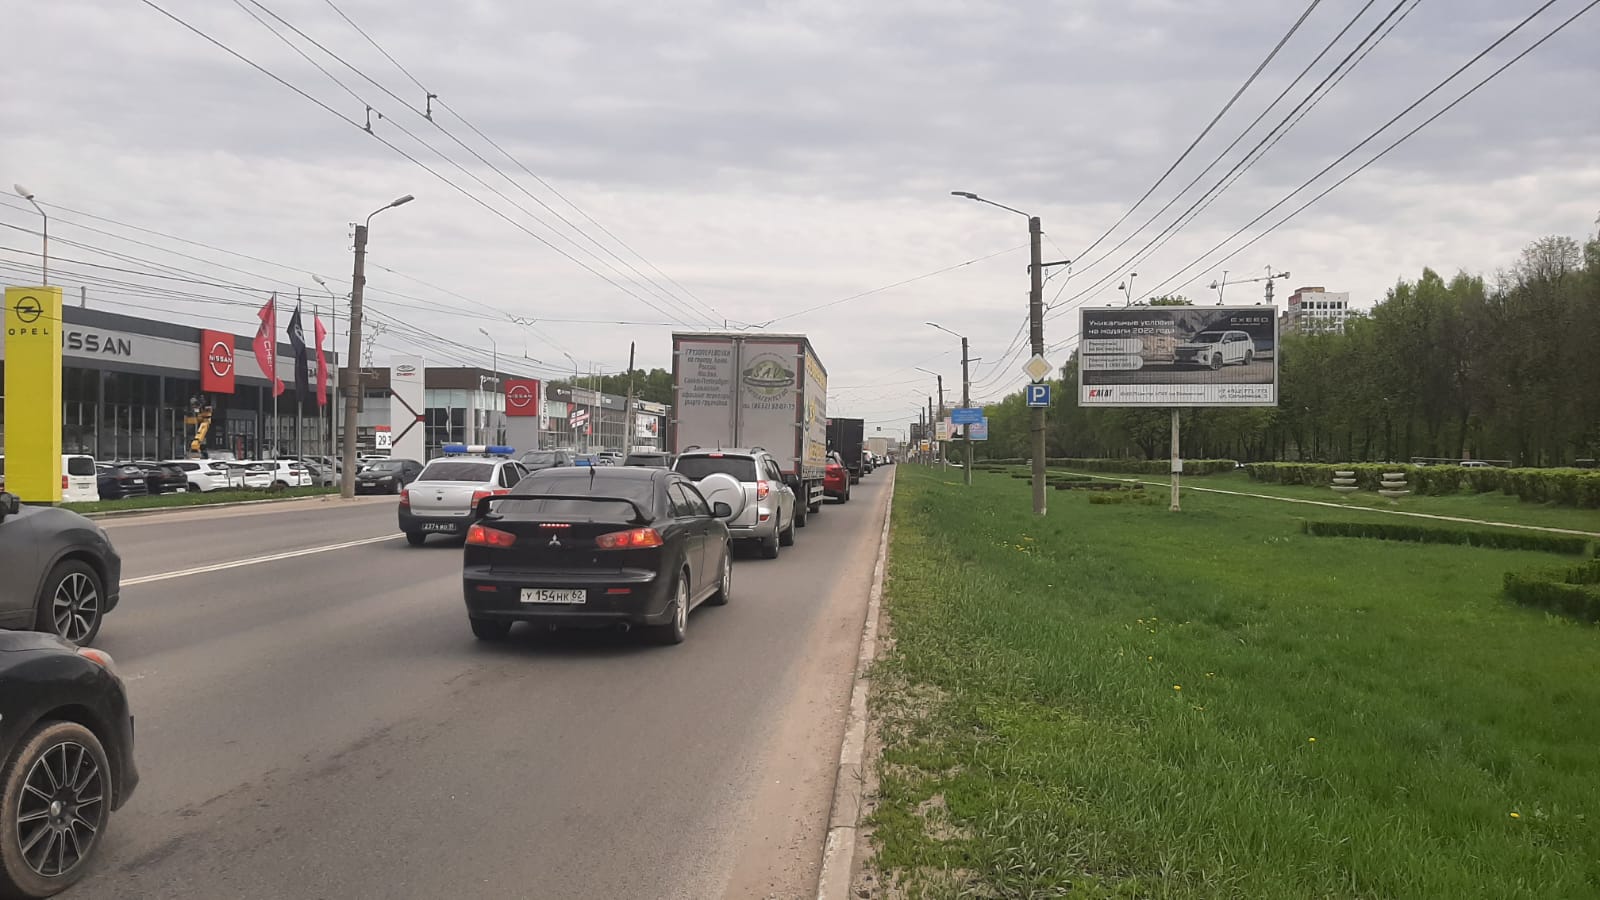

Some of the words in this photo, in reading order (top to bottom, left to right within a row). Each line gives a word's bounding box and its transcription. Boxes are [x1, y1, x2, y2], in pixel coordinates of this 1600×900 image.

[1088, 319, 1139, 327] Уникальные
[1140, 319, 1175, 328] условия
[8, 328, 49, 336] OPEL
[62, 330, 131, 356] ISSAN
[209, 355, 233, 363] NISSAN
[1033, 386, 1046, 402] P
[378, 435, 387, 446] 29
[571, 590, 583, 600] 62
